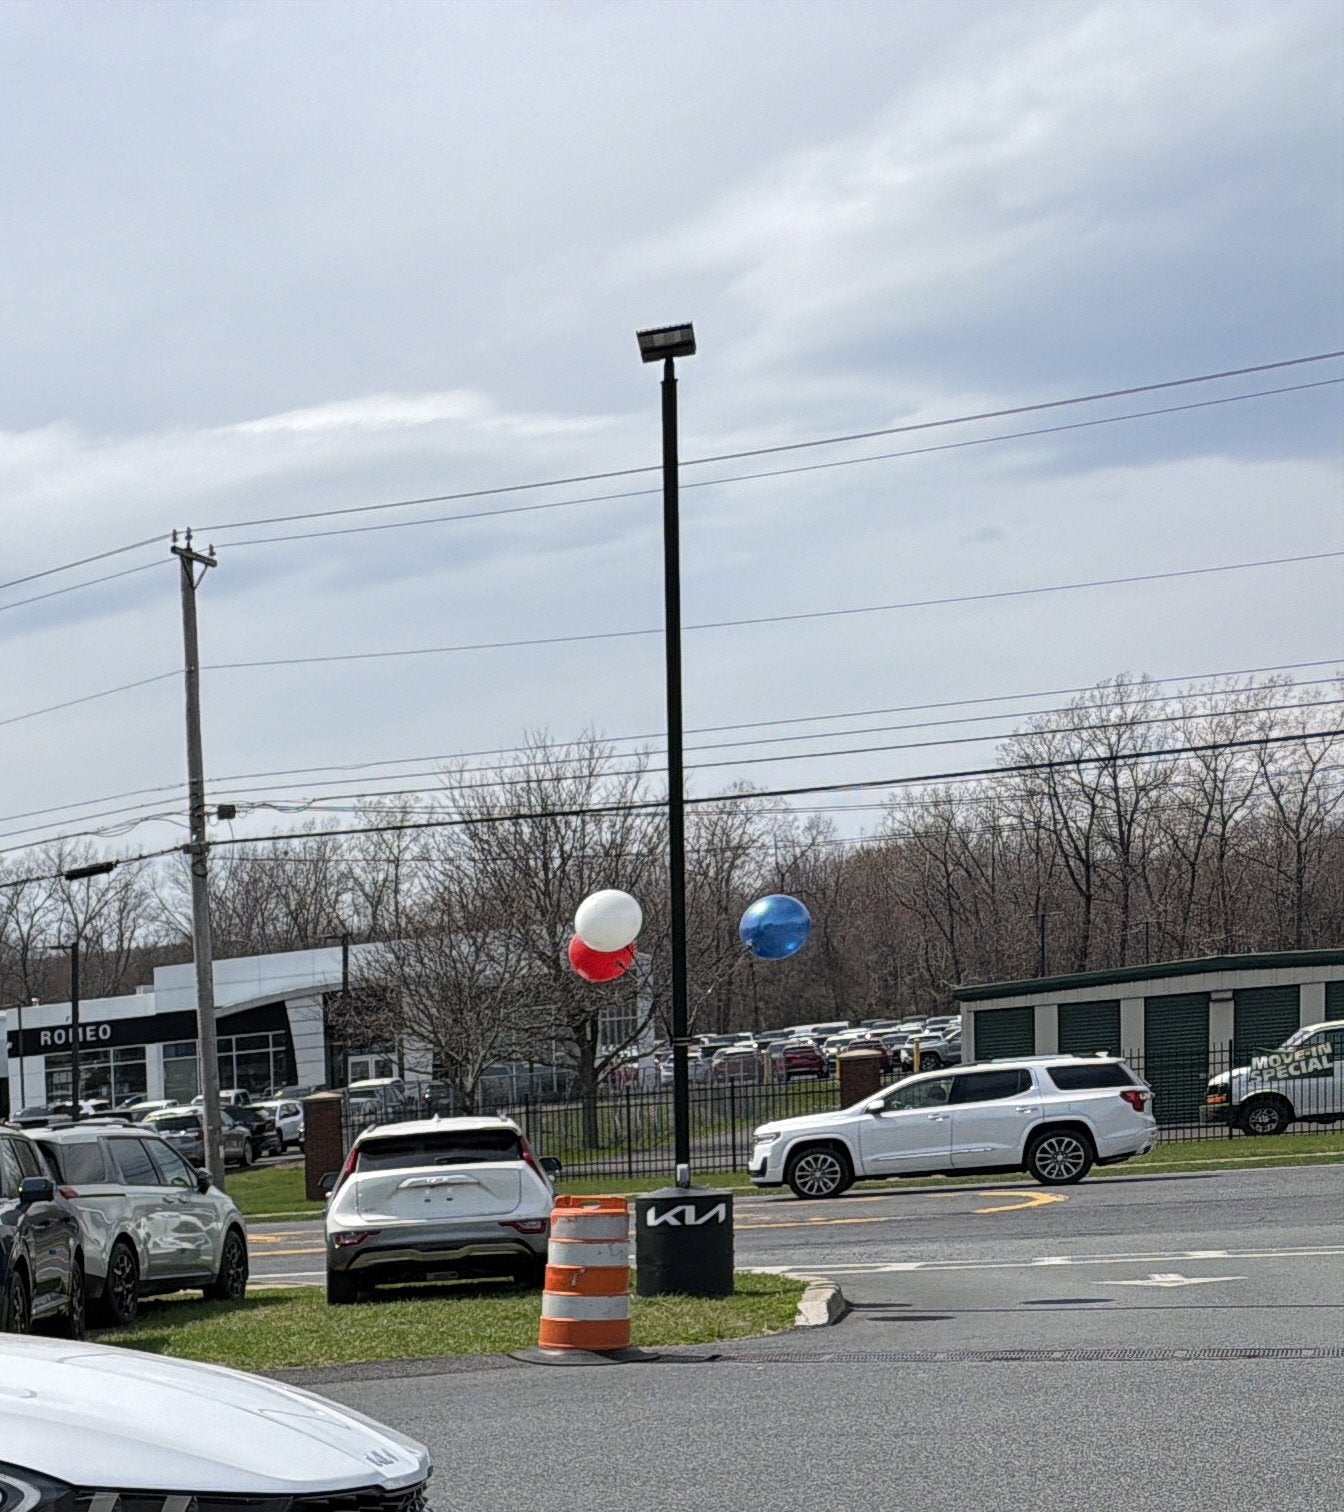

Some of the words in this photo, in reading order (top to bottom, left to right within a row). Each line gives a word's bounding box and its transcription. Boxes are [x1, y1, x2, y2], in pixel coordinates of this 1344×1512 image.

[1250, 1055, 1333, 1083] SPECIAL
[1252, 1042, 1332, 1070] MOVE-IN
[647, 1203, 726, 1226] KIA
